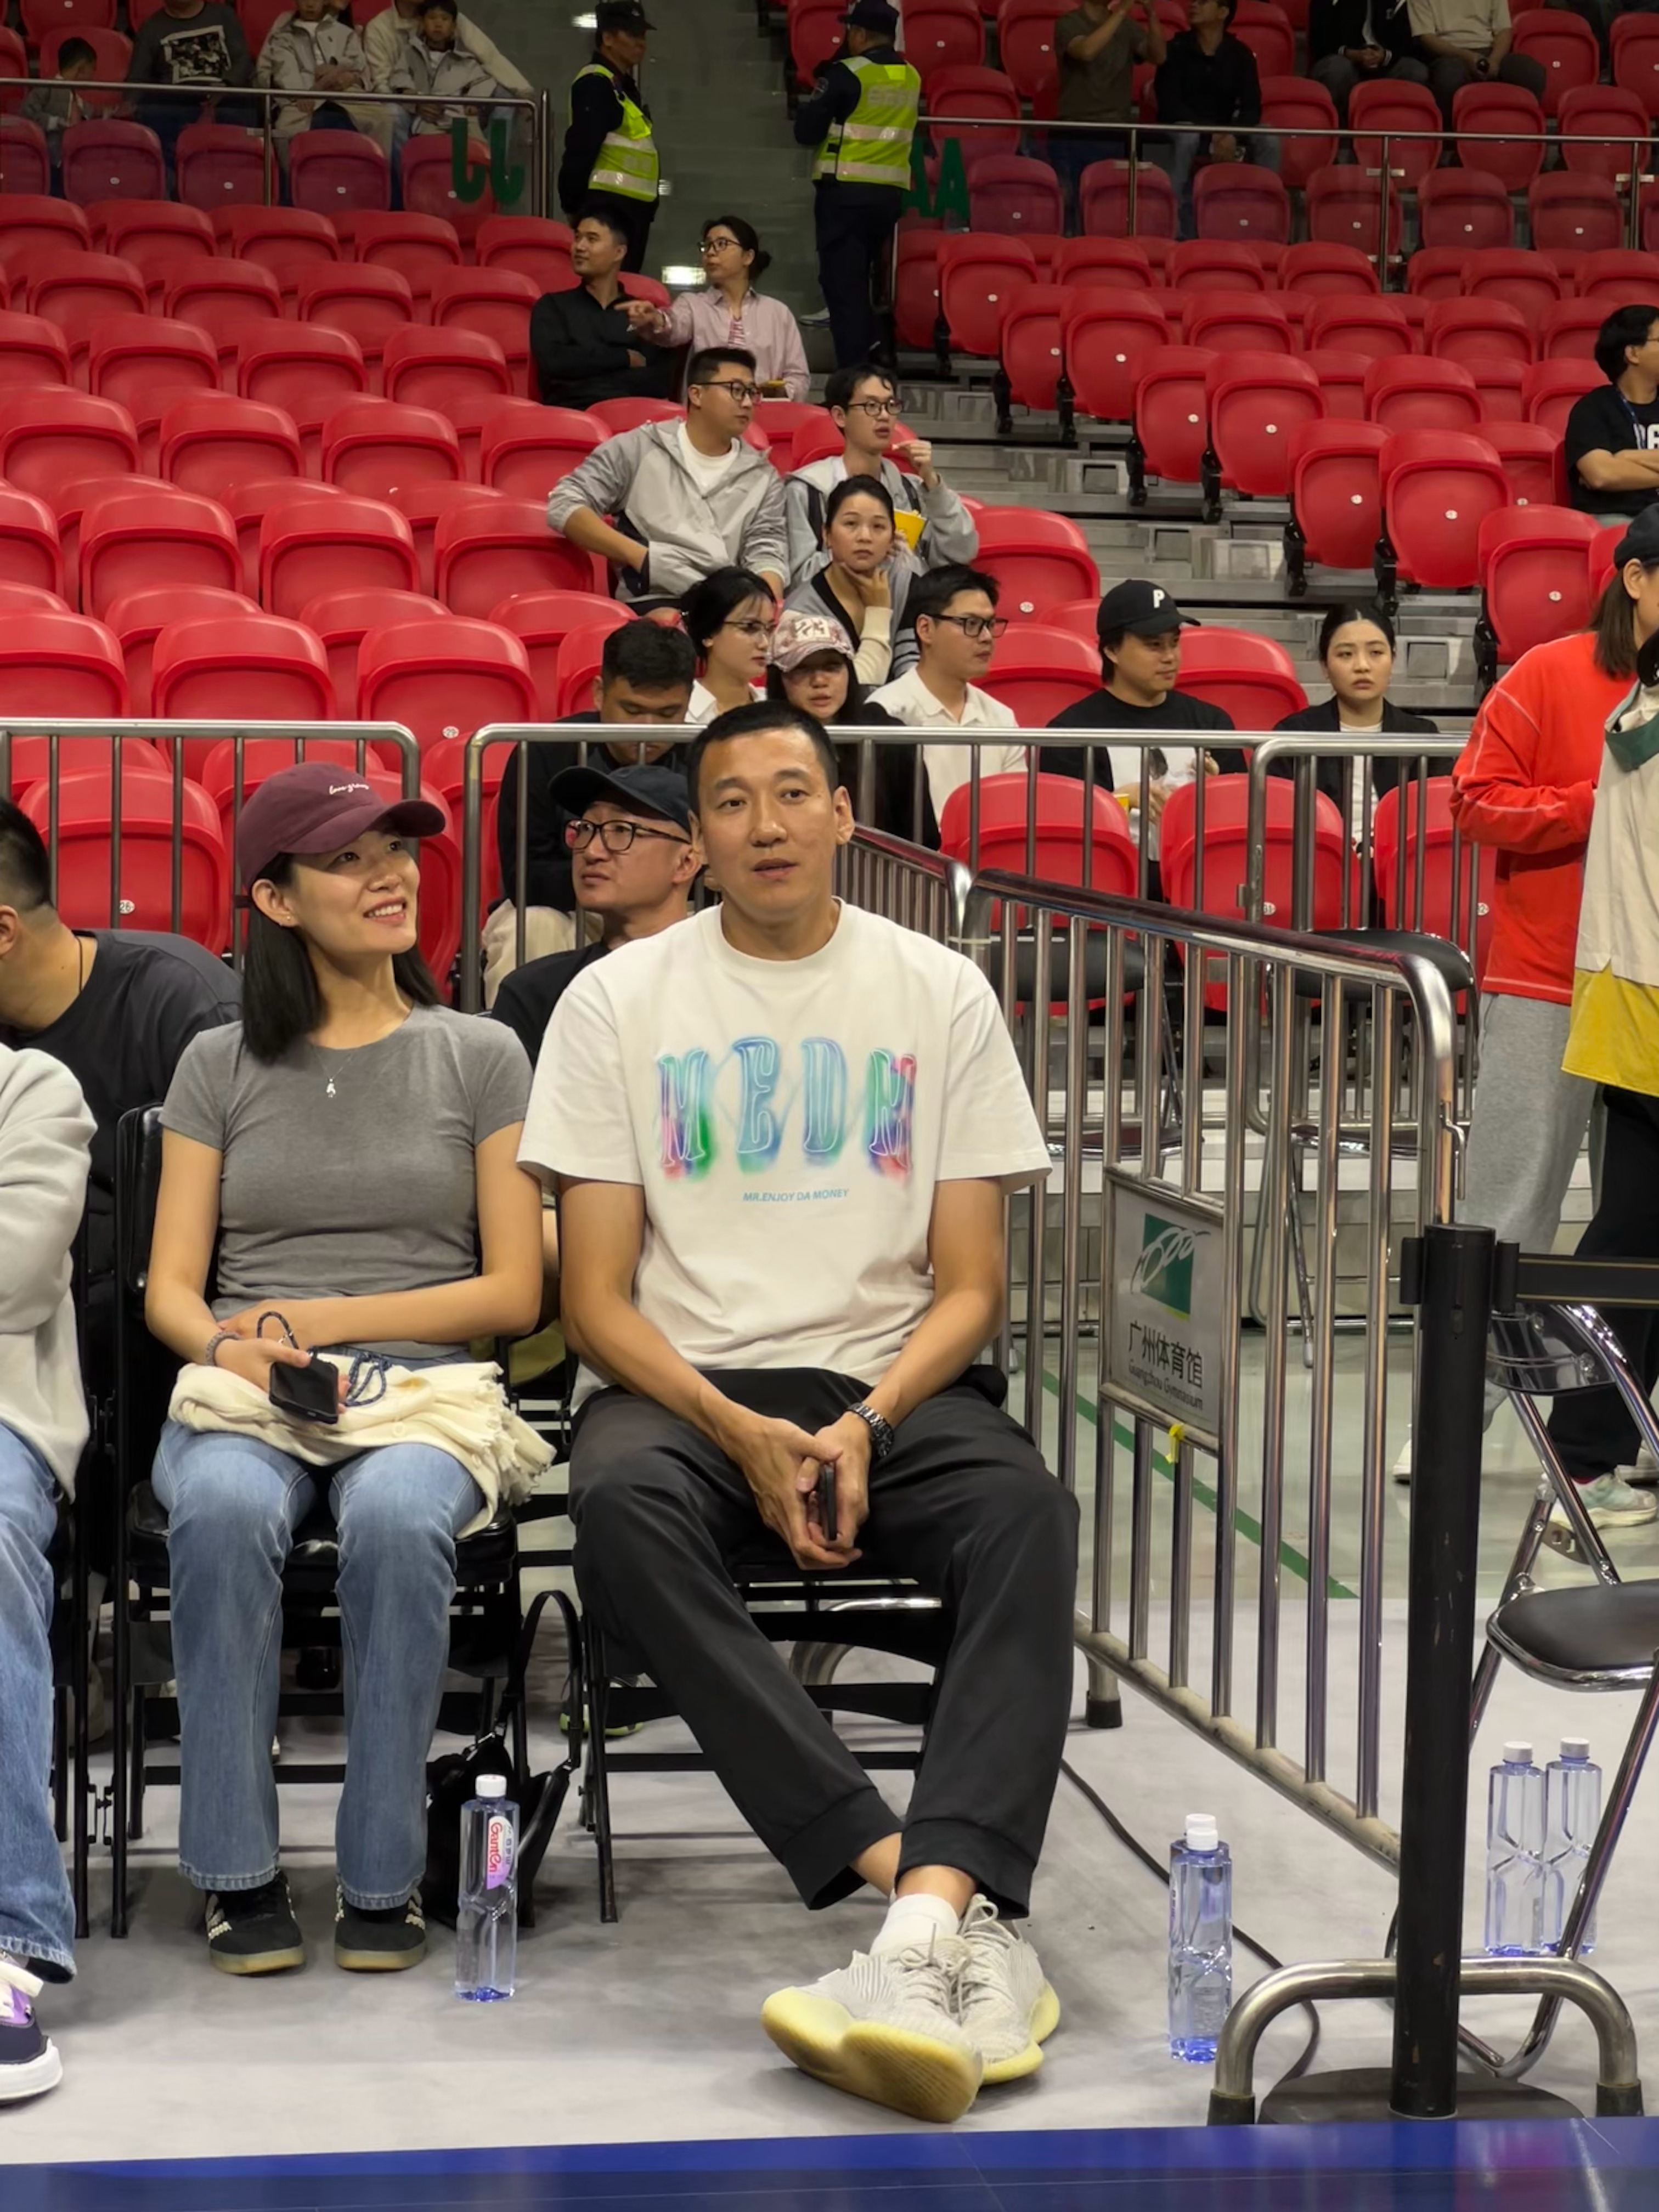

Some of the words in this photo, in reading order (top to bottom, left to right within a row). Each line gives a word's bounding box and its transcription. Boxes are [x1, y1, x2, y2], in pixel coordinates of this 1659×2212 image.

[1153, 589, 1165, 608] P
[797, 1192, 810, 1201] DA
[812, 1188, 849, 1200] MONEY
[1128, 1320, 1203, 1390] 广州体育馆
